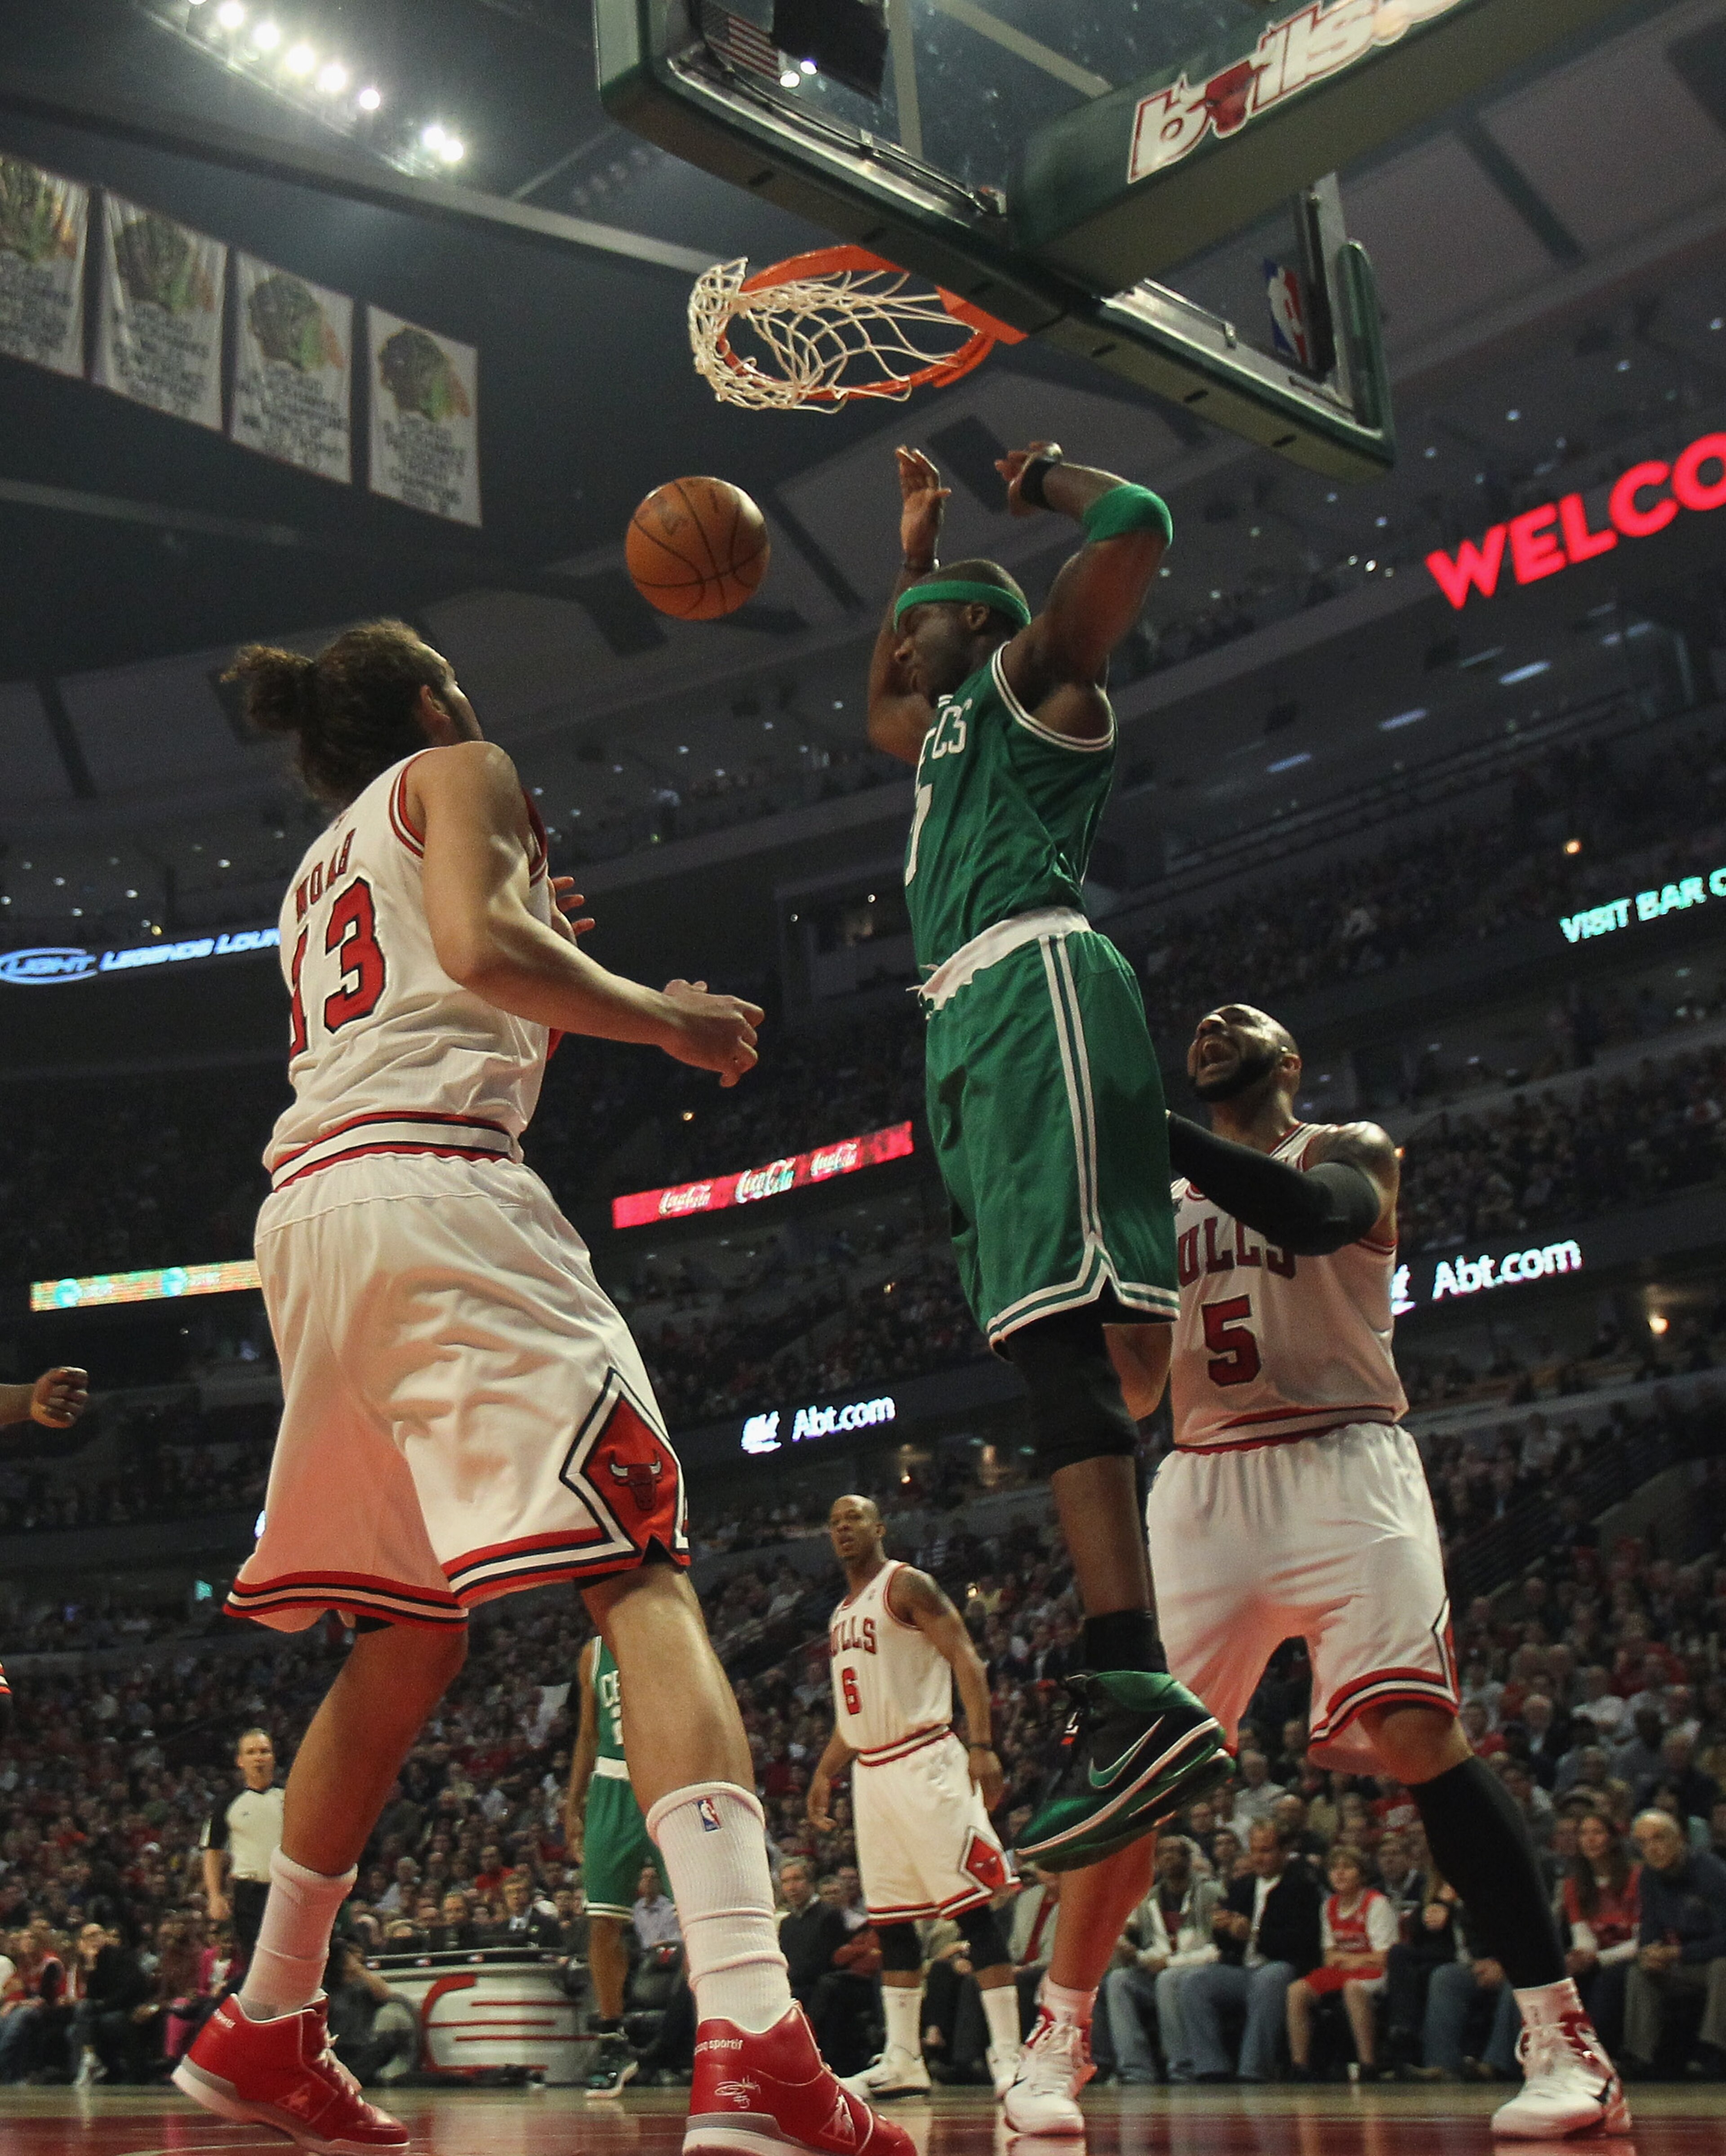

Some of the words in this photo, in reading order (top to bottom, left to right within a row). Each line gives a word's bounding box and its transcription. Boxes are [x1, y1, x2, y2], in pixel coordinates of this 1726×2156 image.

[1424, 432, 1726, 610] WELCO
[1559, 898, 1632, 943] VISIT
[1635, 876, 1708, 922] BAR
[1432, 1239, 1583, 1301] Abt.com
[1201, 1294, 1262, 1387] 5
[792, 1396, 896, 1442] Abt.com
[842, 1666, 862, 1715] 6
